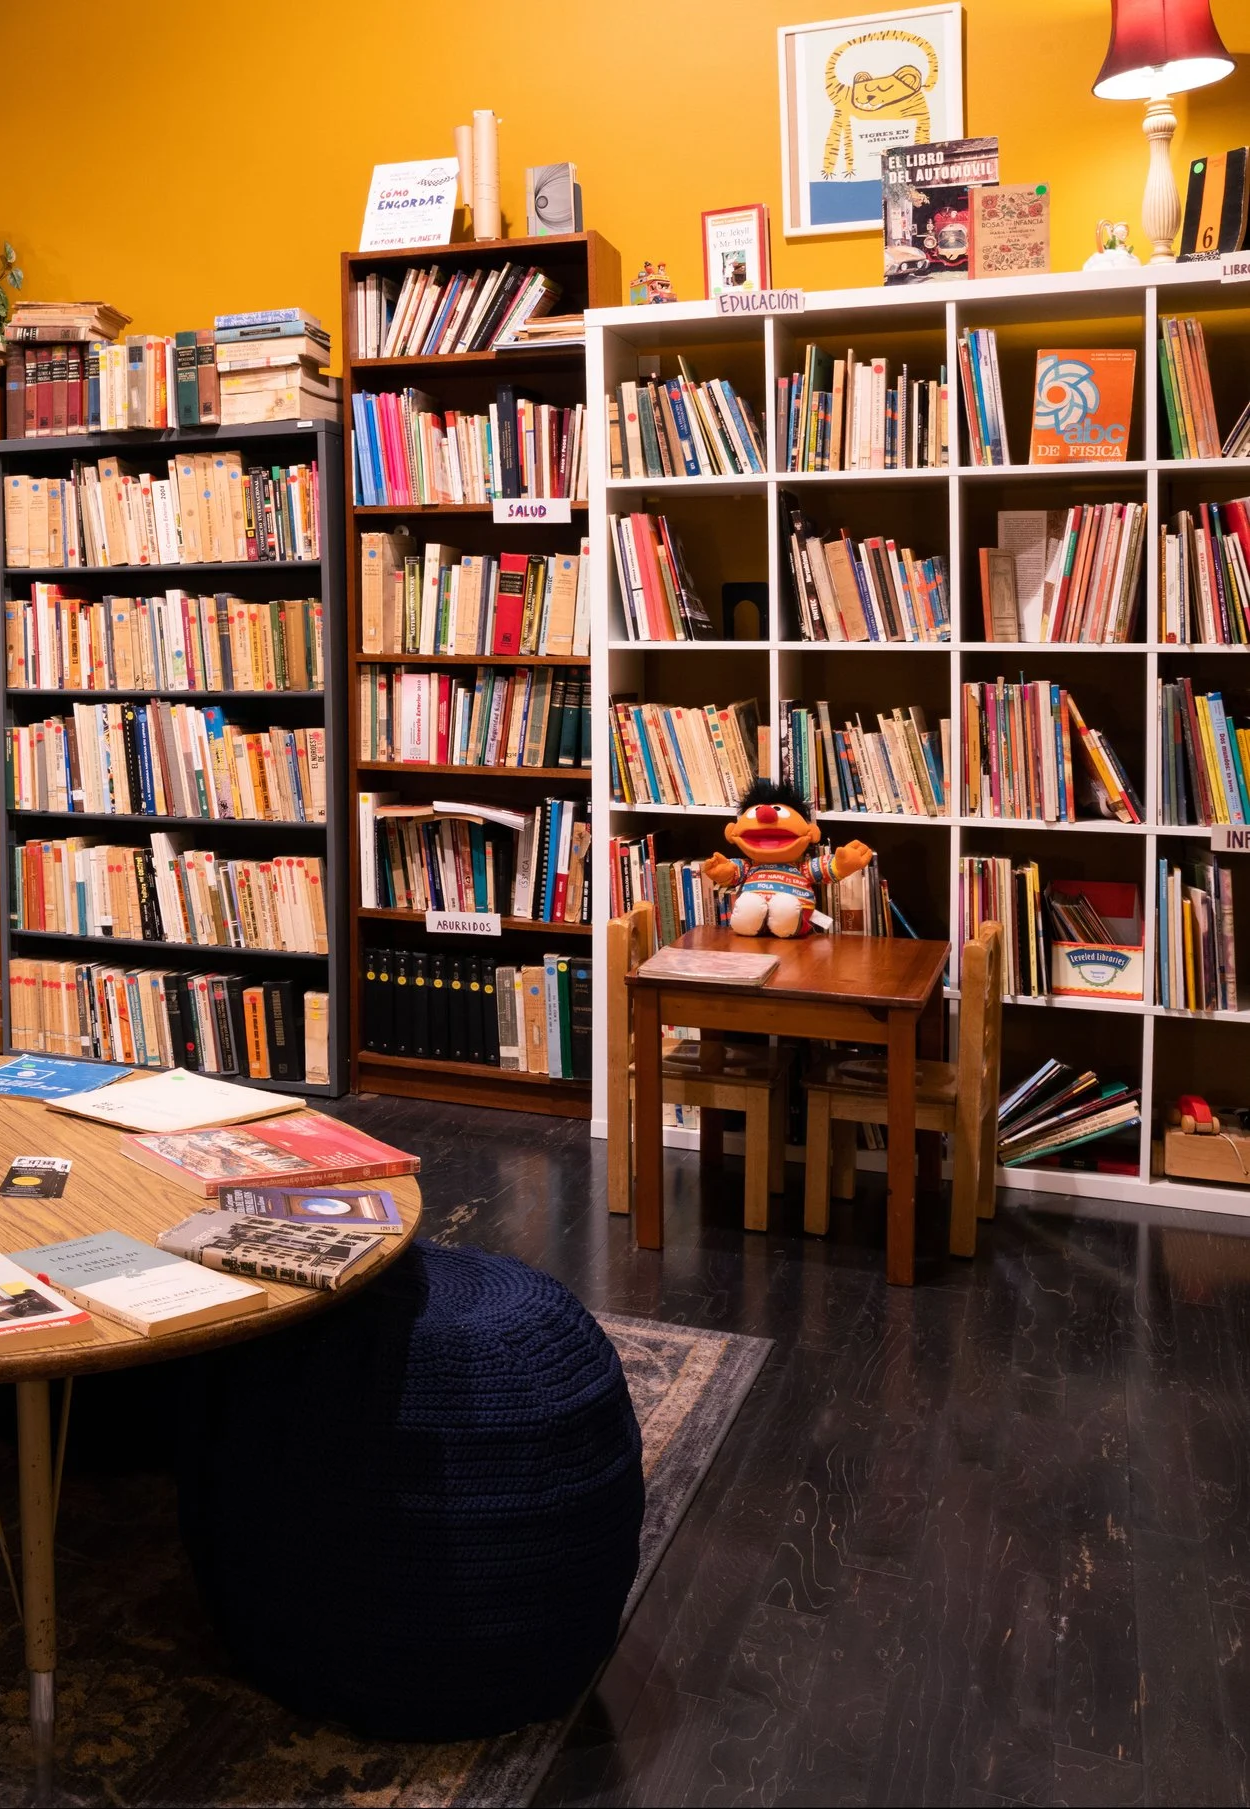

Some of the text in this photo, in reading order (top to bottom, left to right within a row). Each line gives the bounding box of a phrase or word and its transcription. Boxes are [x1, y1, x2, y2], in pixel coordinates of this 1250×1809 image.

[858, 130, 894, 139] TIGRES
[867, 135, 910, 144] alta mar
[888, 151, 944, 170] EL LIBRO
[889, 162, 993, 184] DEL AUTOMÓVIL
[380, 188, 409, 199] CÓMO
[377, 195, 445, 211] ENGORDAR
[981, 218, 1044, 229] ROSAS INFANCIA
[730, 227, 750, 237] Jekyll
[1202, 227, 1214, 248] 6
[370, 233, 441, 246] EDITORIAL PLANETA
[734, 237, 753, 247] Hyde
[719, 290, 799, 313] EDUCACIÓN
[1063, 417, 1125, 444] abc
[1037, 445, 1123, 457] DE FISICA
[508, 504, 547, 518] SALUD
[810, 598, 819, 621] UNITEC
[792, 888, 810, 897] HELLO
[436, 920, 492, 932] ABURRIDOS
[1070, 952, 1125, 966] Leveled Libraries
[49, 1244, 115, 1264] LA GAVIOTA
[58, 1250, 141, 1273] LA FAMILIA DE
[83, 1257, 140, 1274] ALVAREDA
[16, 1323, 49, 1334] Planeta
